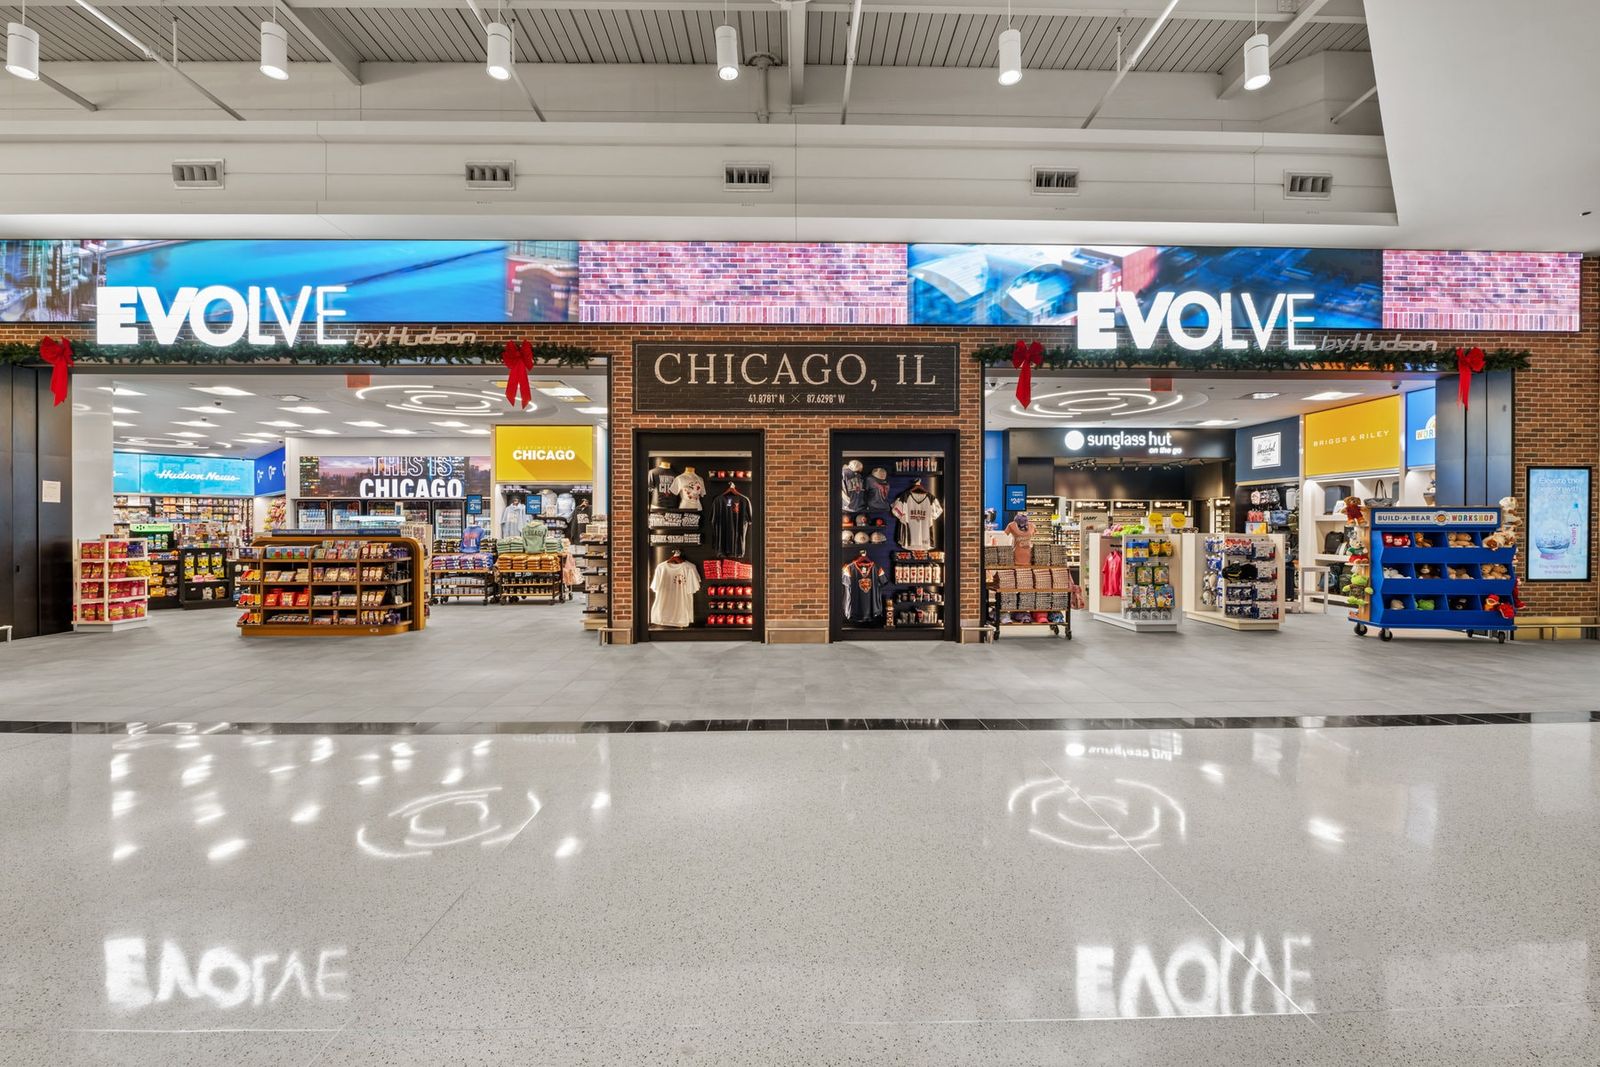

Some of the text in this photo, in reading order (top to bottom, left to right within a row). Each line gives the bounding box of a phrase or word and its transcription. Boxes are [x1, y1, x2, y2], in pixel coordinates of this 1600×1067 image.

[97, 285, 347, 347] EVOLVE
[1077, 290, 1316, 351] EVOLVE
[354, 327, 477, 348] by Hudson
[1319, 333, 1438, 353] by Hudson
[654, 353, 936, 391] CHICAGO, IL
[779, 394, 785, 403] N
[838, 394, 846, 403] W
[1087, 430, 1172, 449] sunglass hut
[1313, 434, 1348, 447] BRIGGS
[1359, 430, 1390, 441] RILEY
[512, 449, 576, 460] CHICAGO
[1148, 446, 1183, 455] on the go
[157, 469, 240, 481] Hudson News
[369, 456, 453, 477] THIS IS
[359, 478, 463, 498] CHICAGO
[1452, 514, 1495, 522] WORKSHOP
